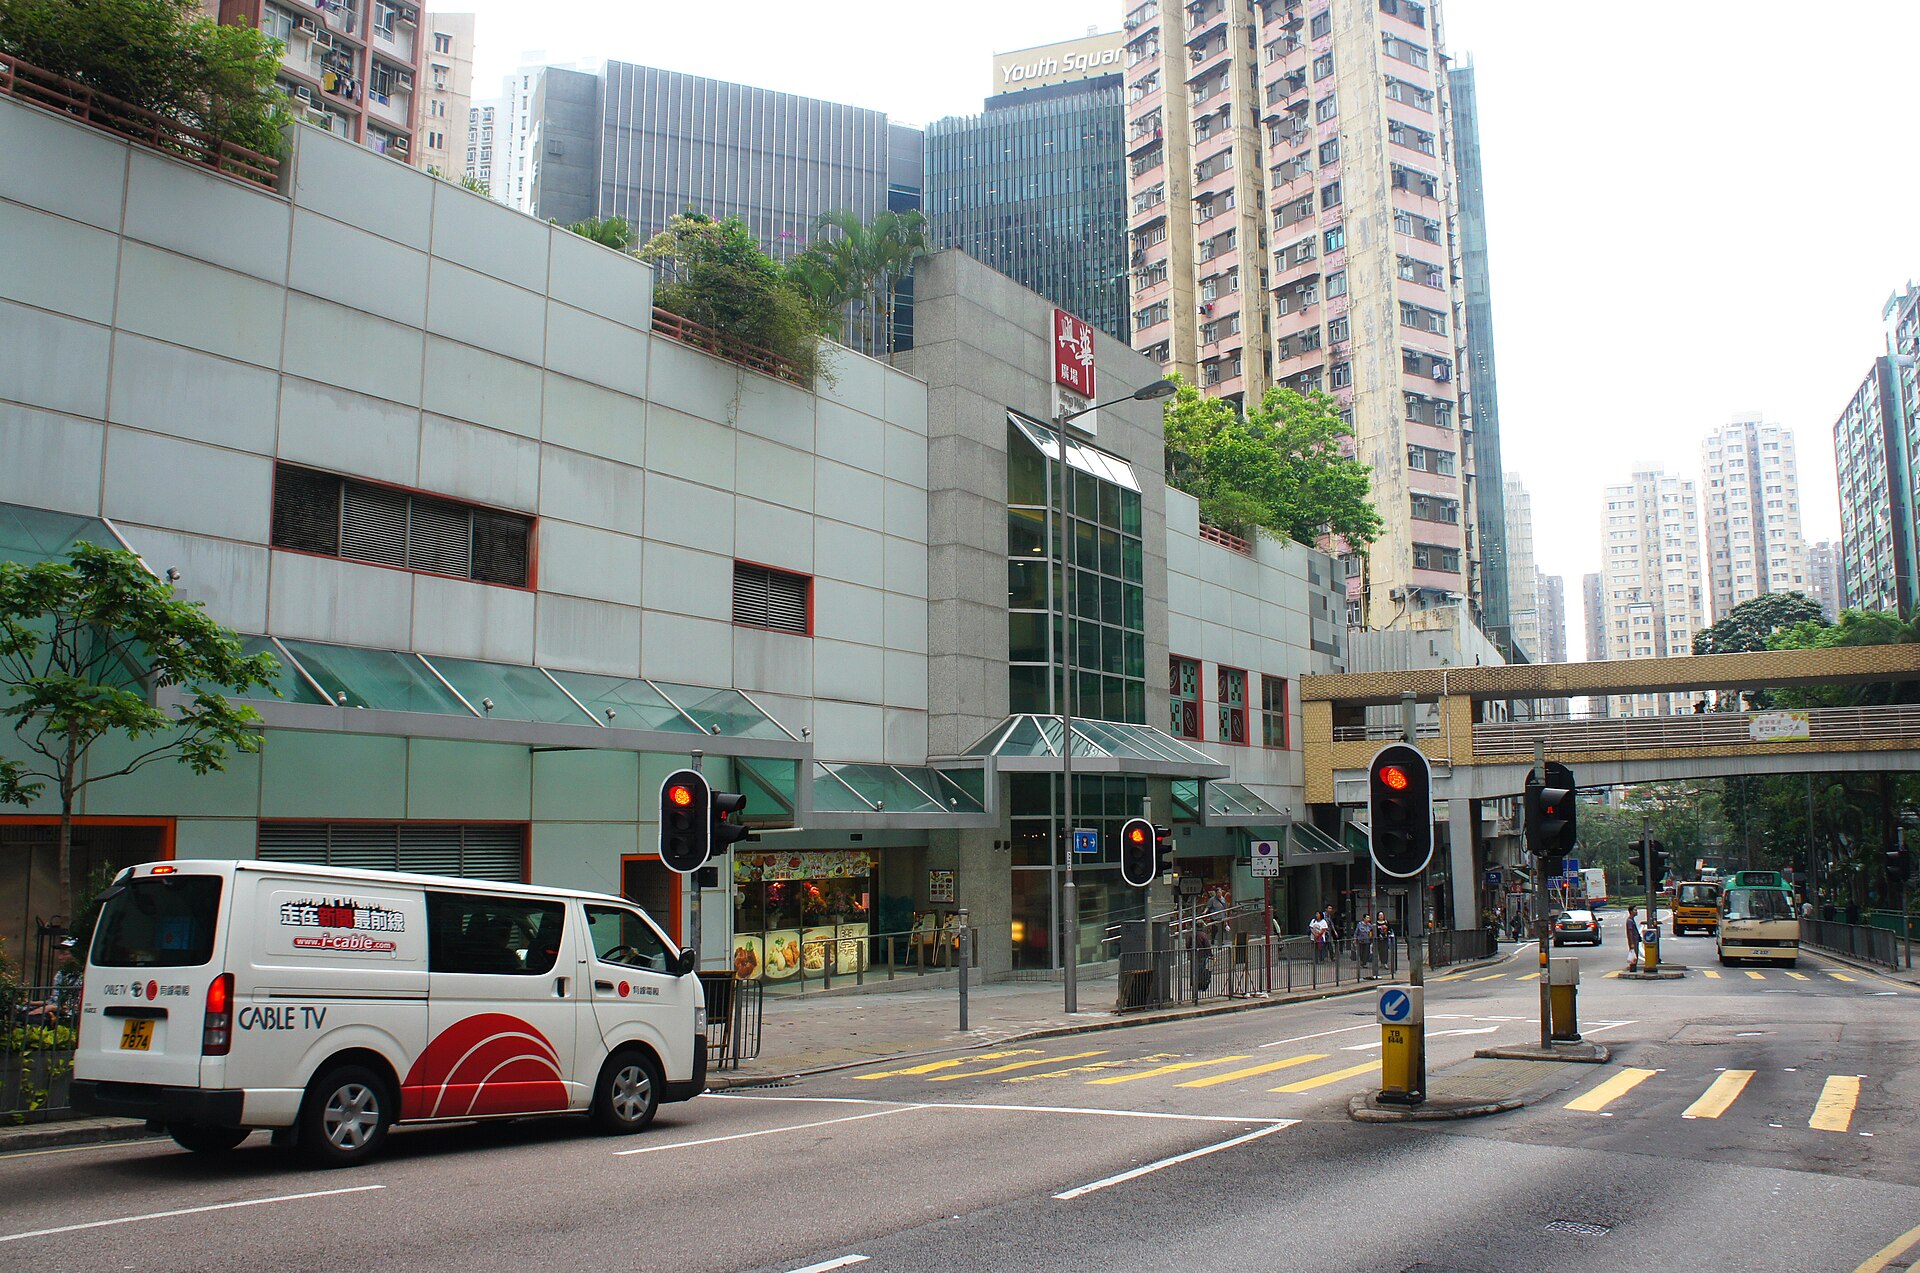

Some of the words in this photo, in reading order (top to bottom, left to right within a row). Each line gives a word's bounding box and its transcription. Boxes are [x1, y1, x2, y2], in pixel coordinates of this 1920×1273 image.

[1001, 58, 1058, 84] Youth
[1061, 48, 1123, 73] Squar
[1269, 868, 1277, 876] 12
[280, 904, 405, 932] 走在新聞最前線
[296, 933, 391, 950] www.i-cable.com
[238, 1006, 296, 1031] CABLE
[300, 1006, 327, 1030] TV
[121, 1033, 149, 1050] 7874
